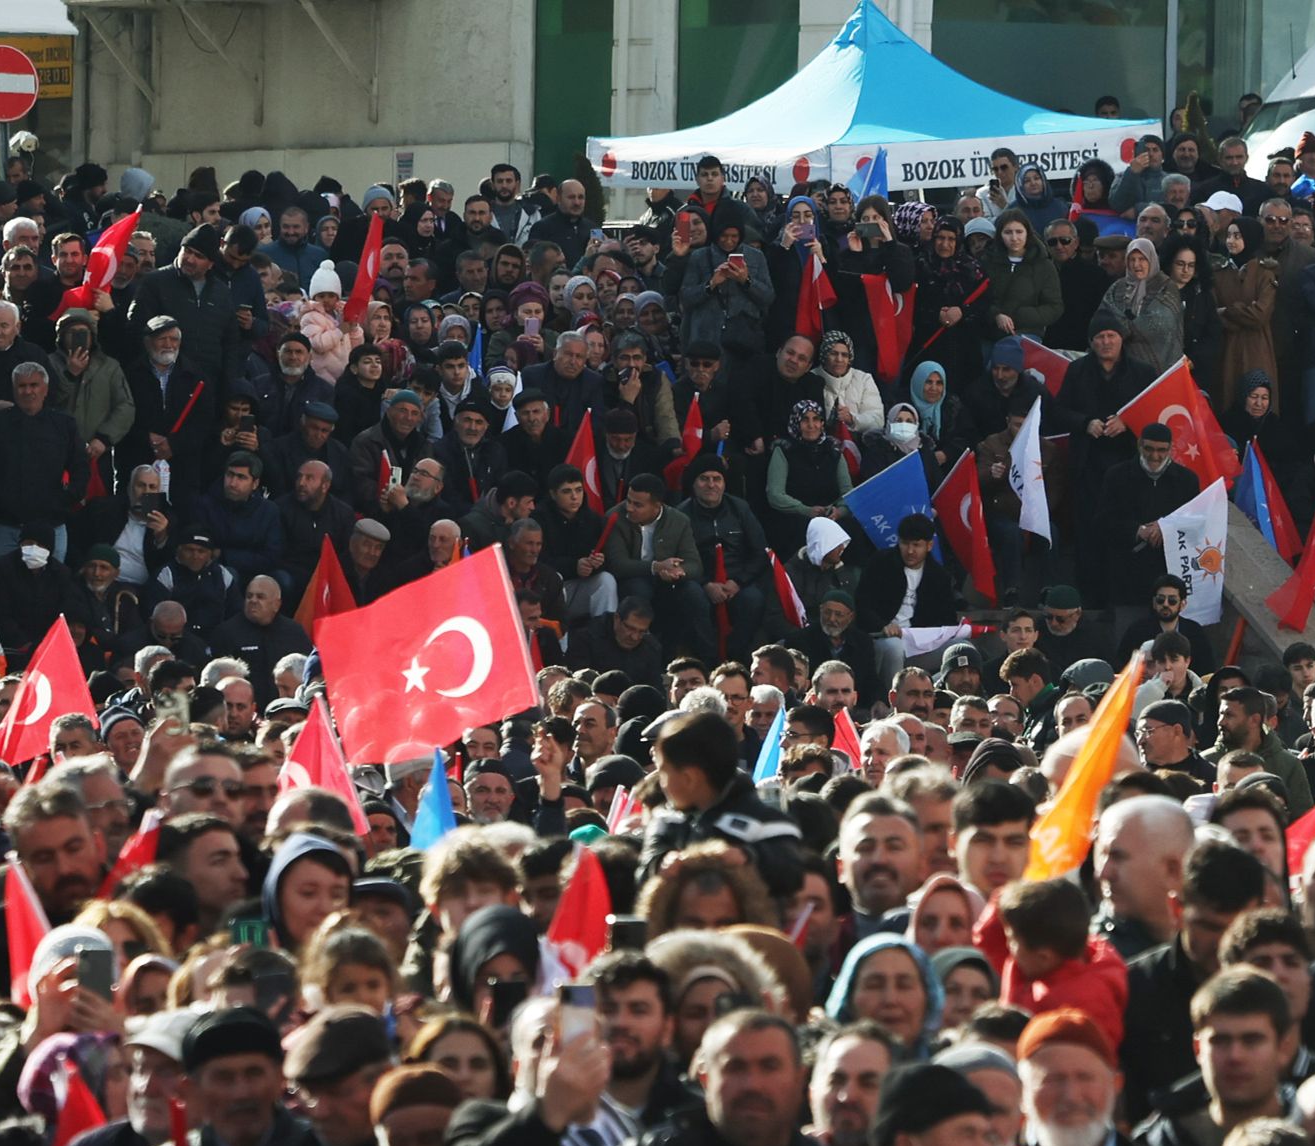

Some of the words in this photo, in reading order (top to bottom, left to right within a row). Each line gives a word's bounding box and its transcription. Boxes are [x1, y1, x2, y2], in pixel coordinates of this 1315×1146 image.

[631, 160, 678, 181] BOZOK
[902, 158, 965, 182] BOZOK
[970, 142, 1099, 178] ÜNERSİTESİ
[871, 514, 892, 534] AK
[1177, 530, 1186, 551] AK
